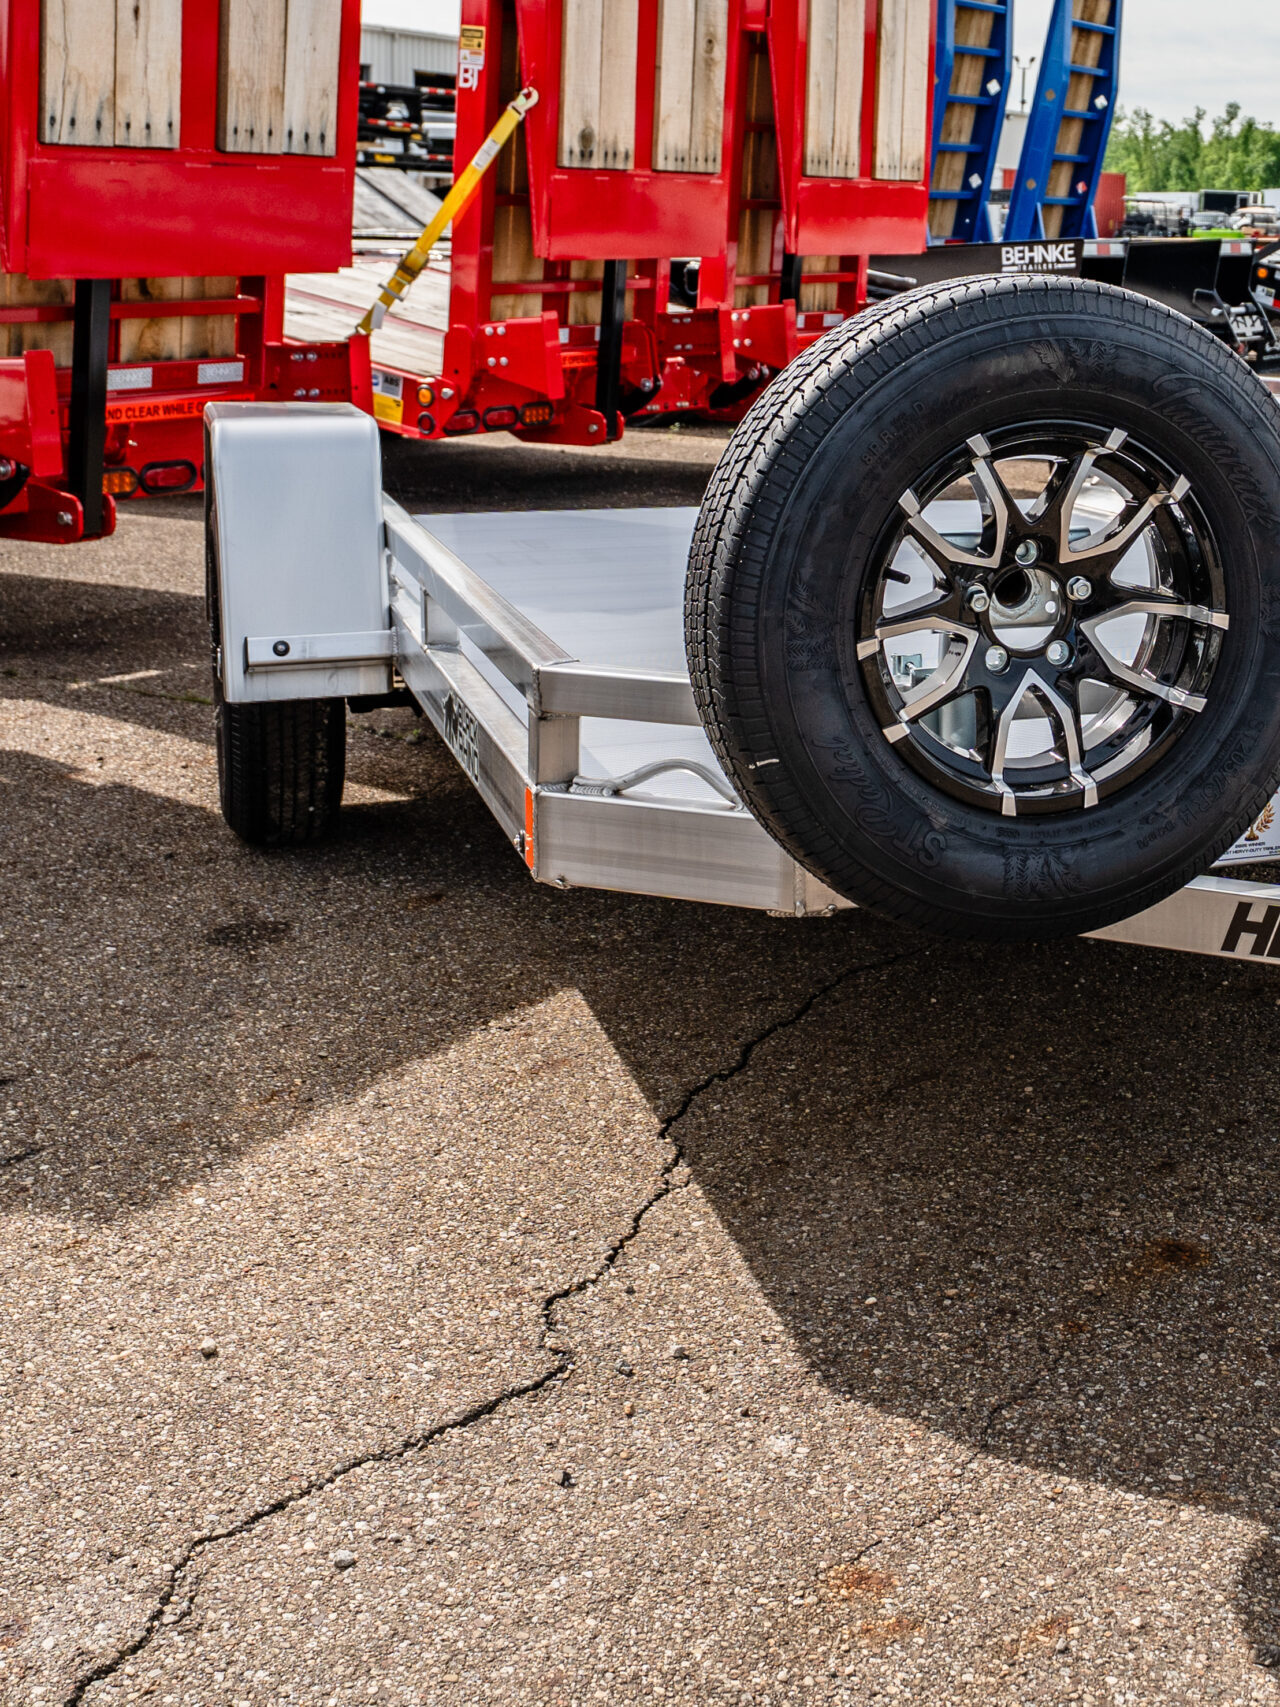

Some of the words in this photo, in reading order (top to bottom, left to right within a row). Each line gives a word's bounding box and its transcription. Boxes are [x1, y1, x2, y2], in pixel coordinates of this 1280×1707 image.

[1001, 243, 1076, 266] BEHNKE
[125, 405, 160, 419] CLEAR
[163, 402, 194, 415] WHILE
[892, 818, 948, 868] ST
